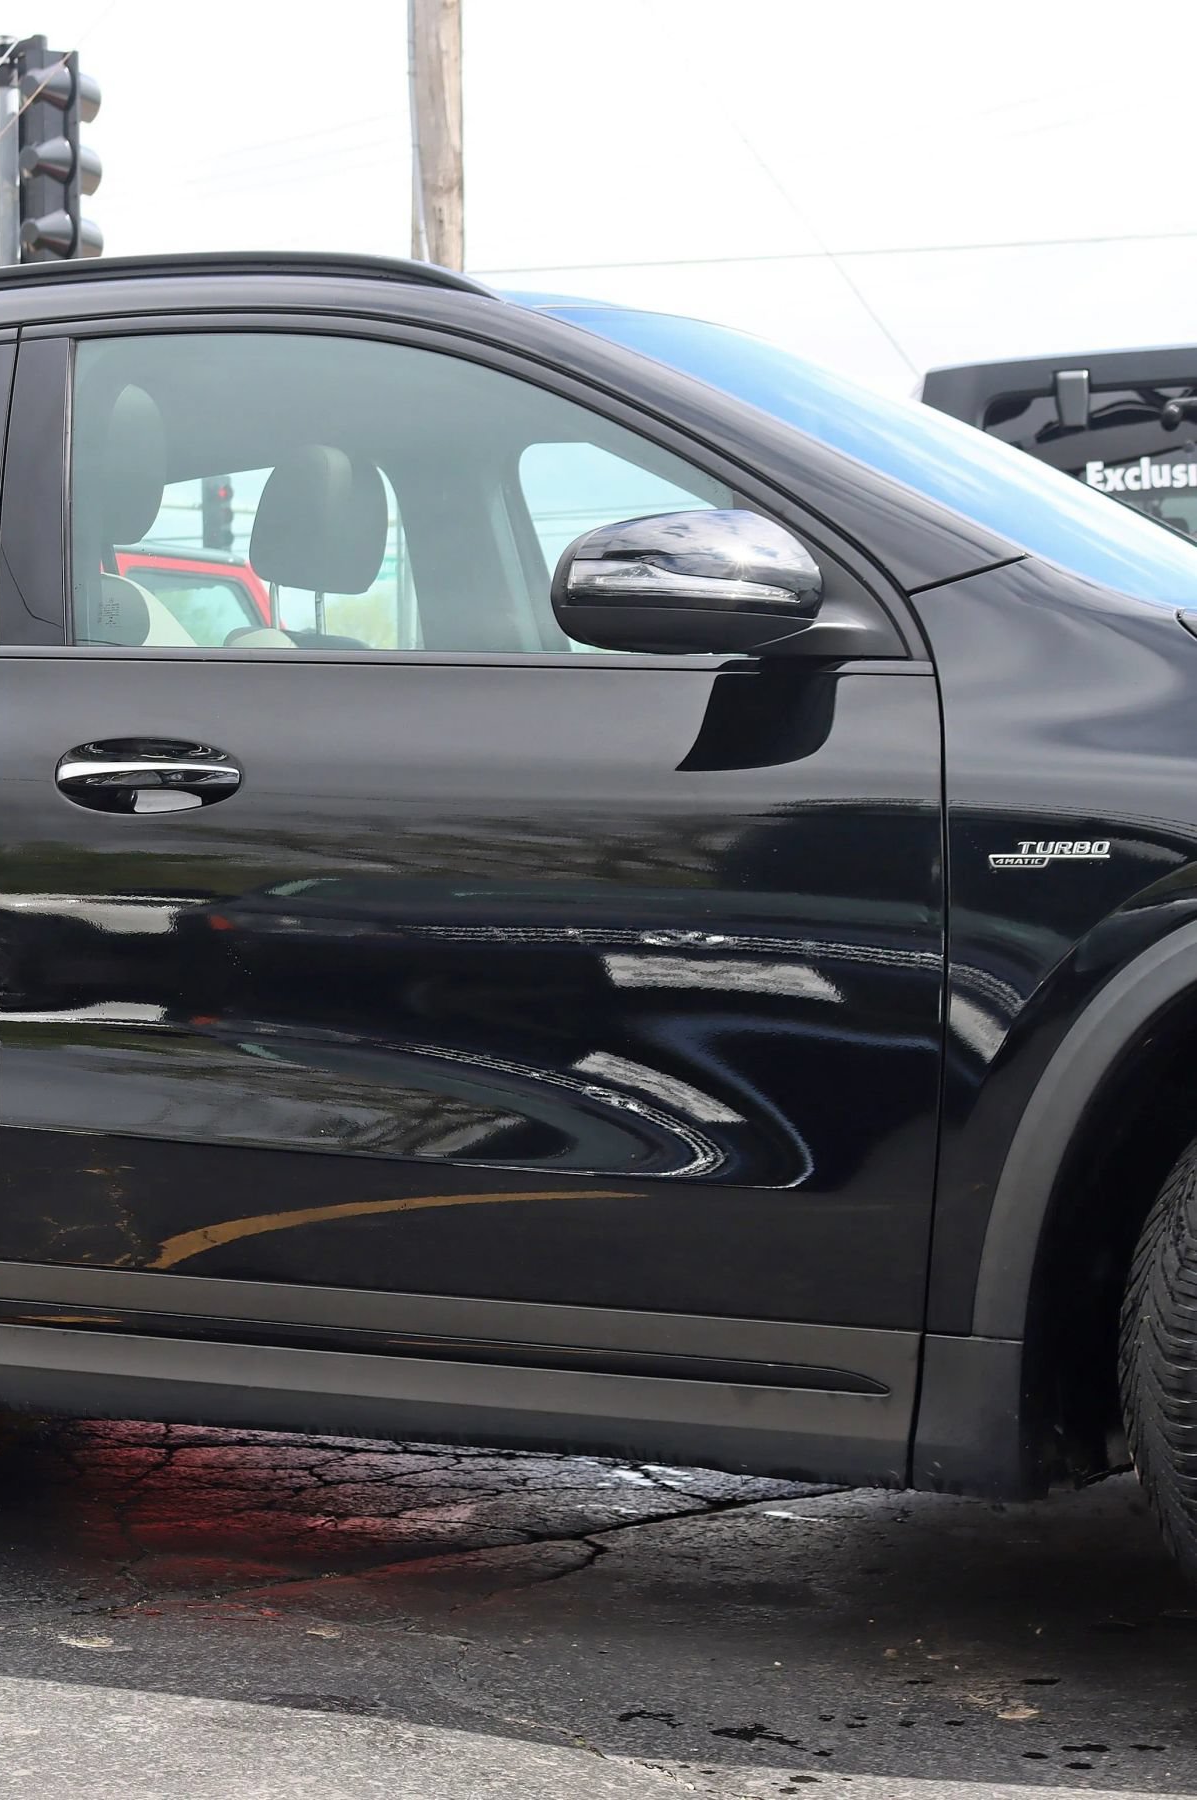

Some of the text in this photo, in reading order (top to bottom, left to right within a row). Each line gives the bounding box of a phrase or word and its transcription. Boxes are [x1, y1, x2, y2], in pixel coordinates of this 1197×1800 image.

[1086, 457, 1197, 492] Exclusi
[1017, 841, 1111, 855] TURBO
[995, 857, 1043, 865] 4MATIC
